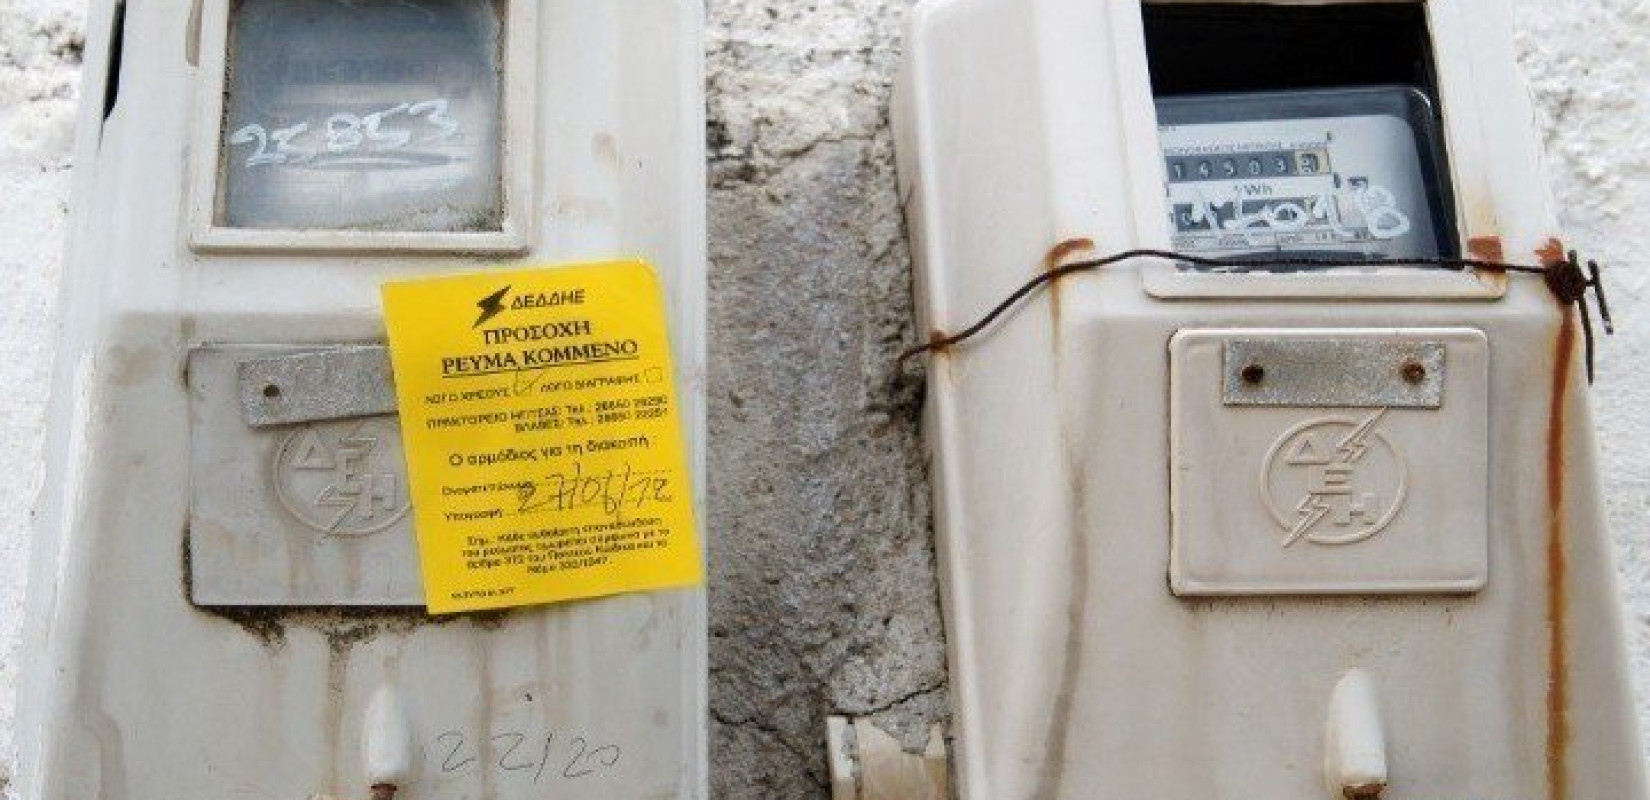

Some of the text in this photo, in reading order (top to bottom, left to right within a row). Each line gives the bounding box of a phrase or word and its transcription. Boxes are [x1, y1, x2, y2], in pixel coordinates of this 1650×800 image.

[511, 288, 585, 310] ΔΕΔΔΗΕ
[483, 320, 592, 345] ΠΡΟΣΟΧΗ
[441, 338, 639, 374] ΡΕΥΜΑ ΚΟΜΜΕΝΟ
[426, 412, 507, 429] ΠΡΑΚΤΟΡΕΙΟ
[447, 452, 464, 466] Ο
[466, 447, 537, 466] αρμόδιος
[540, 445, 562, 460] για
[566, 442, 584, 456] τη
